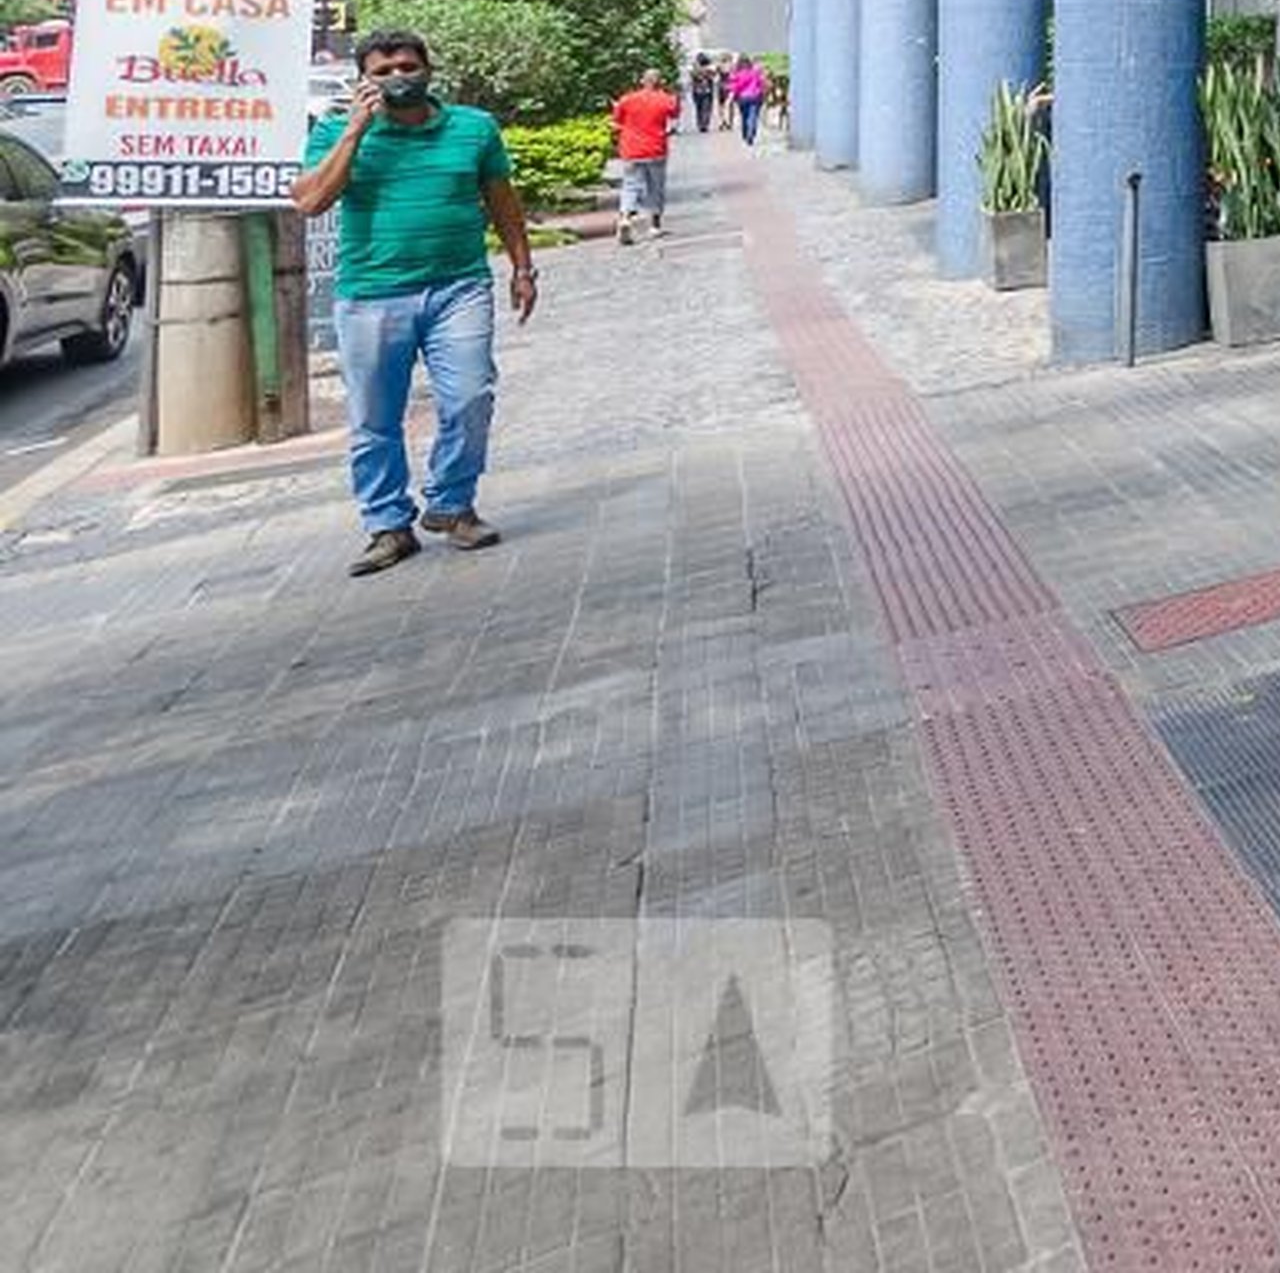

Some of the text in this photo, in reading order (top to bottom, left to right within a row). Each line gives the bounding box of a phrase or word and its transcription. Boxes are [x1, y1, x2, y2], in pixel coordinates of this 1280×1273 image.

[105, 94, 273, 121] ENTREGA
[119, 134, 260, 157] SEM TAXA!
